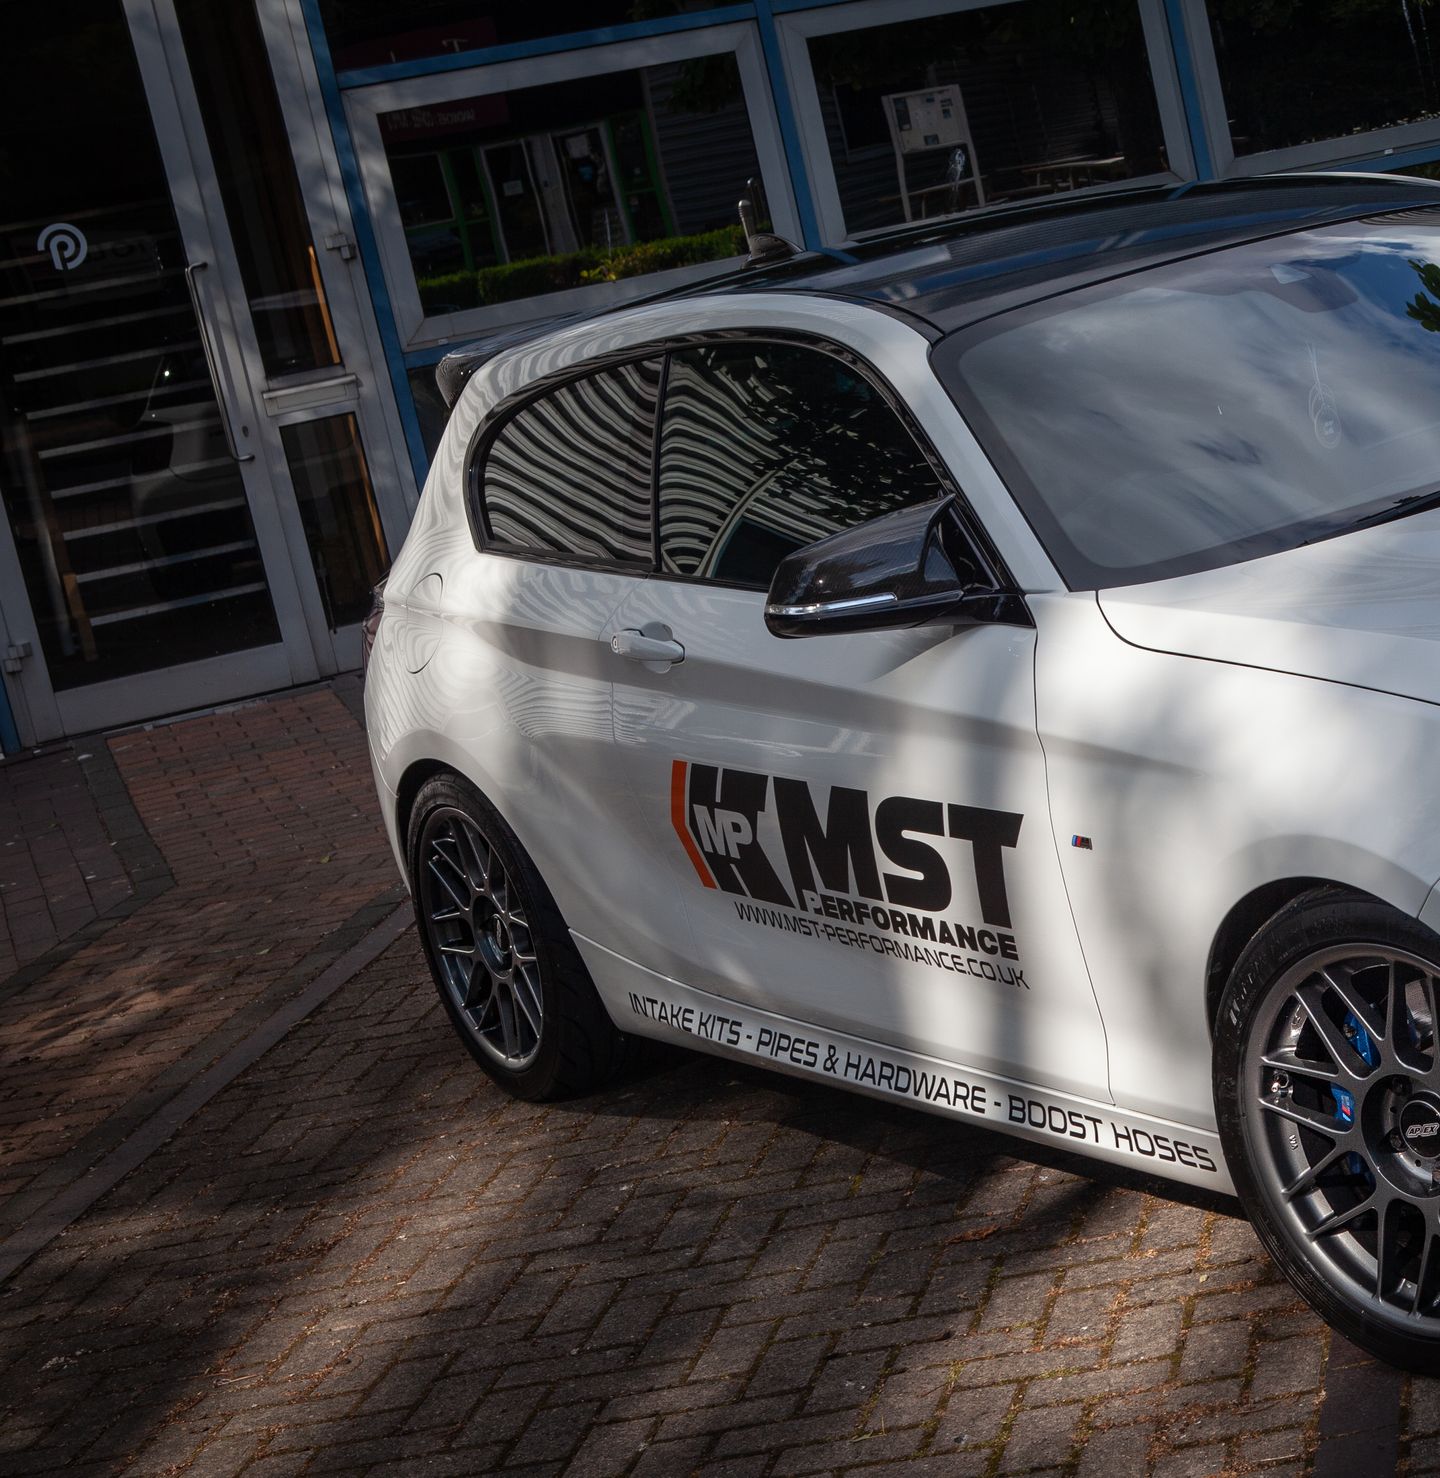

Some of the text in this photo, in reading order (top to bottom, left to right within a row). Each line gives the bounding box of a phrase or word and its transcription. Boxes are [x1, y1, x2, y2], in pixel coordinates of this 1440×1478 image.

[734, 900, 1031, 991] WWW.MST-PERFORMANCE.CO.UK
[801, 888, 1021, 962] PERFORMANCE
[628, 991, 695, 1033] INTAKE
[698, 1011, 743, 1046] KITS
[756, 1027, 820, 1068] PIPES
[823, 1044, 838, 1075] &
[843, 1051, 986, 1114] HARDWARE
[1008, 1094, 1103, 1144] BOOST
[1110, 1121, 1218, 1173] HOSES
